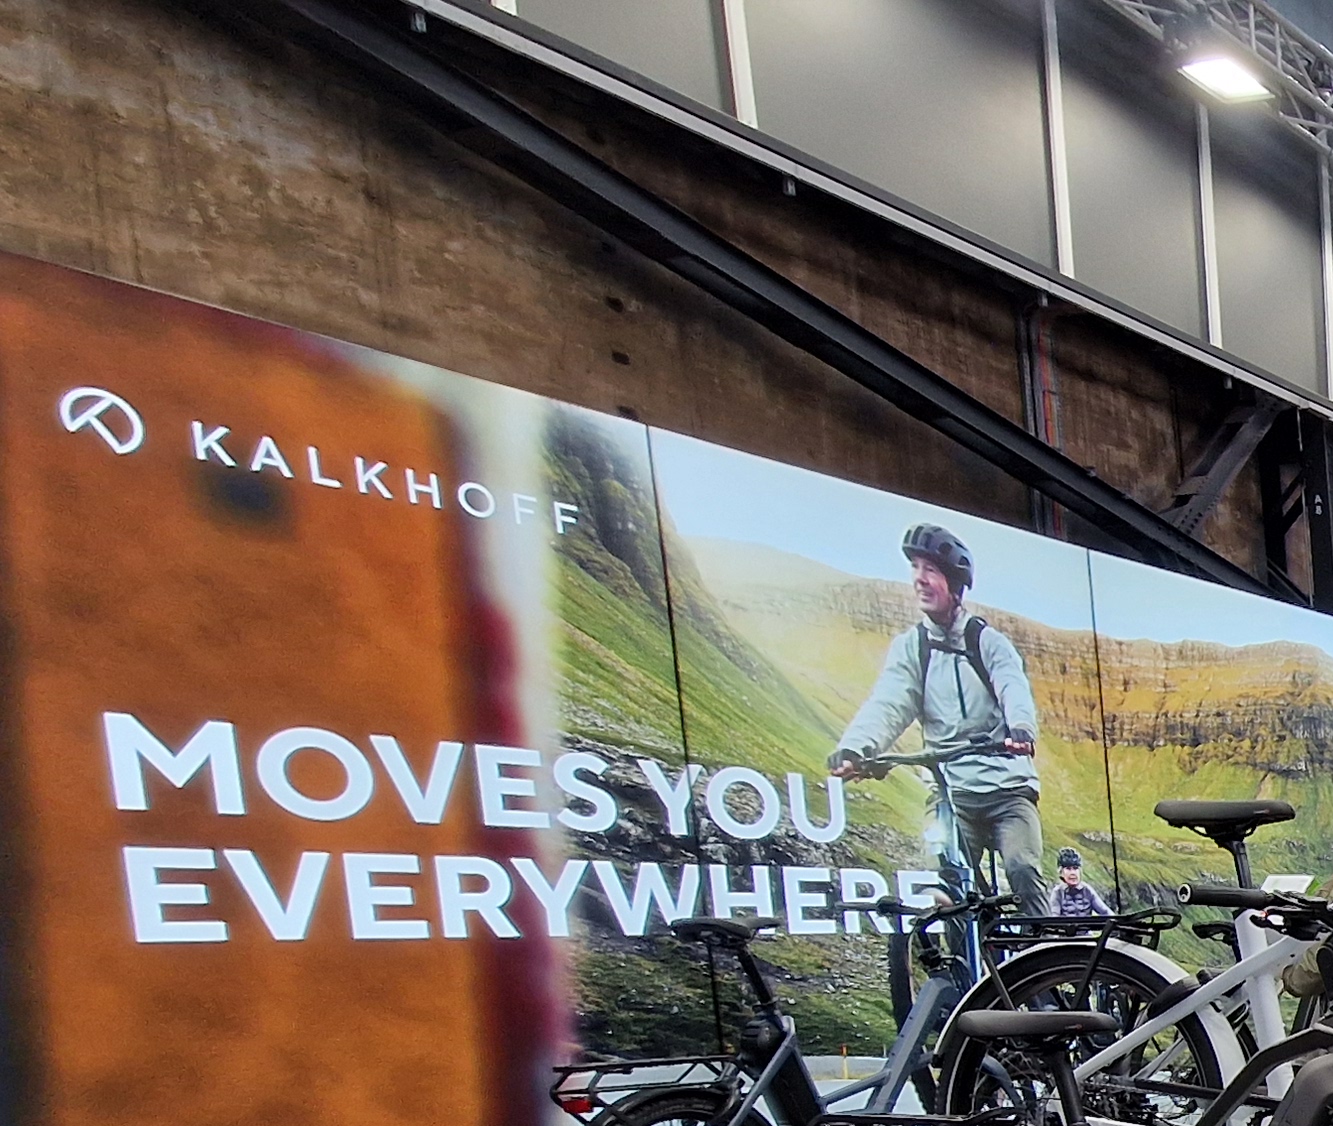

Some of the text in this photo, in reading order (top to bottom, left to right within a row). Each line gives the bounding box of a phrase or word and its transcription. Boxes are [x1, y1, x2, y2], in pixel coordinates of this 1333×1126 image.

[191, 420, 580, 536] KALKHOFF
[103, 711, 847, 844] MOVES YOU
[123, 846, 944, 944] EVERYWHERE
